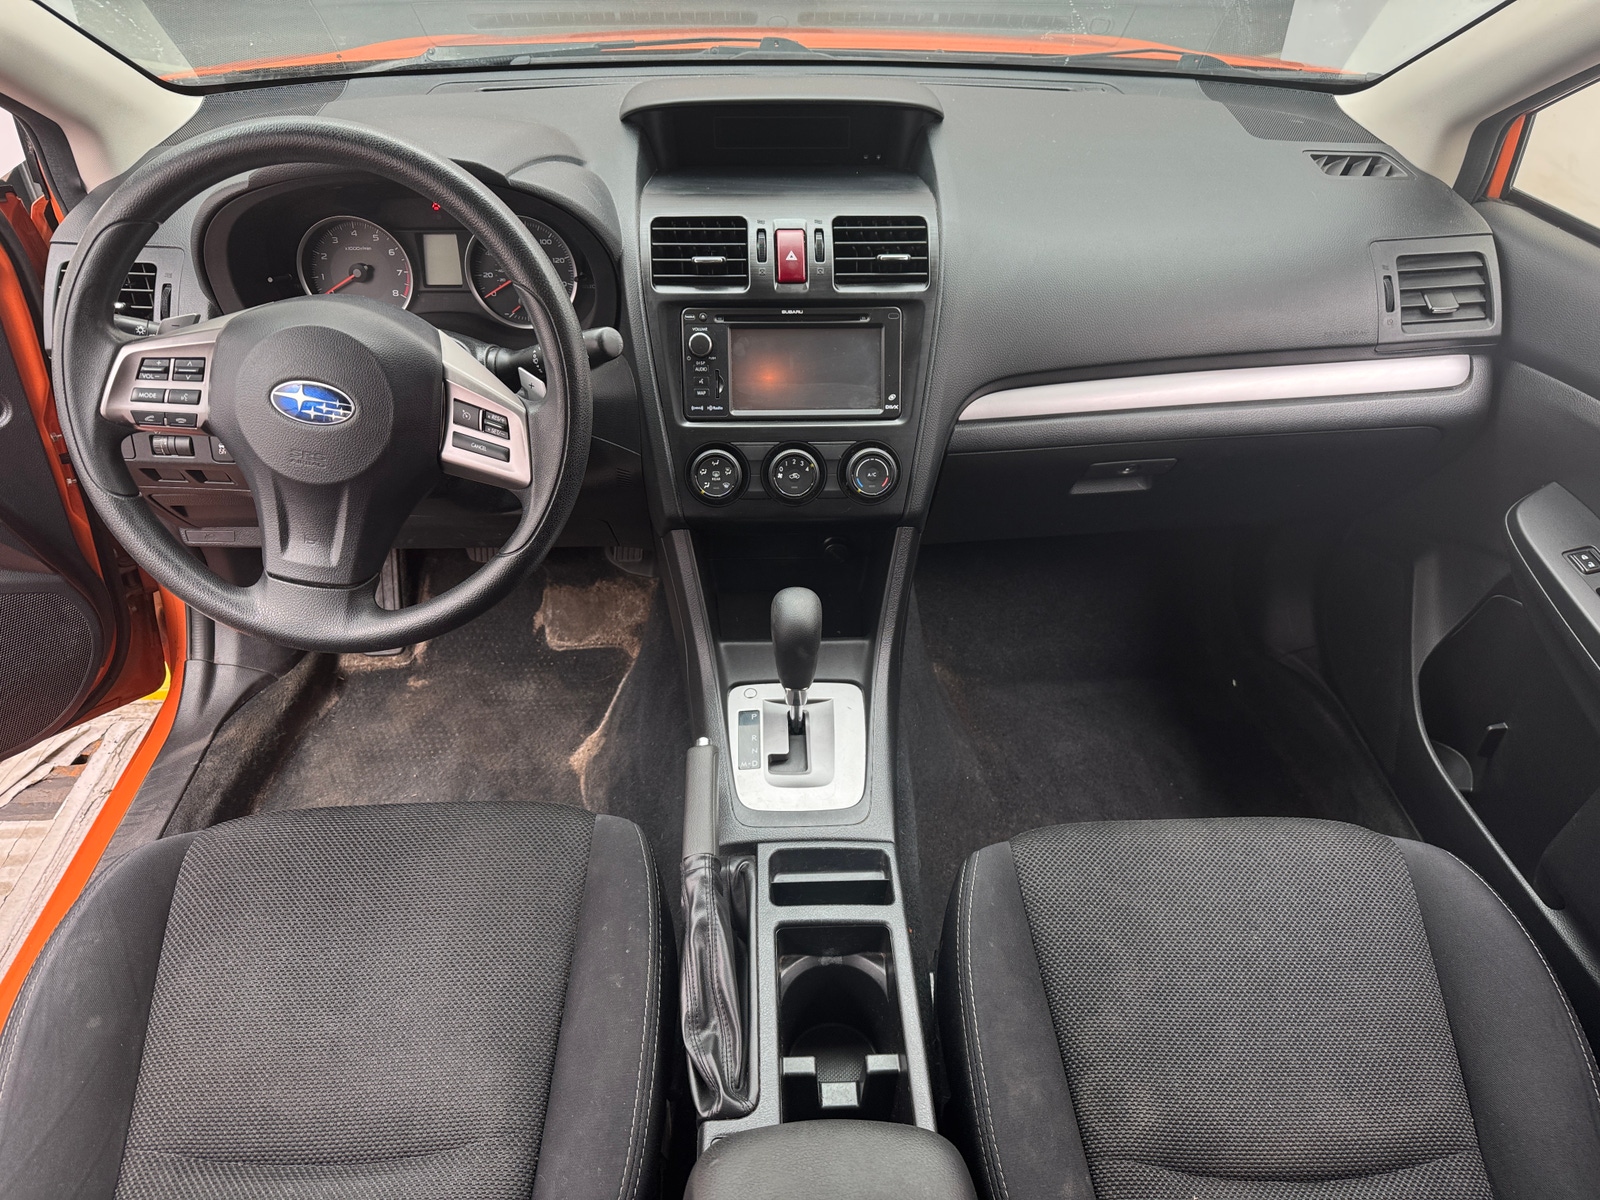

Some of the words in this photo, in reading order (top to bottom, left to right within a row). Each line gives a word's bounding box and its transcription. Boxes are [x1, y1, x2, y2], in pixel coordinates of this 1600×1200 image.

[331, 236, 339, 244] 3
[372, 234, 380, 242] 5
[320, 252, 328, 260] 2
[396, 269, 403, 277] 7
[392, 289, 400, 297] 8
[470, 442, 488, 452] CANCEL
